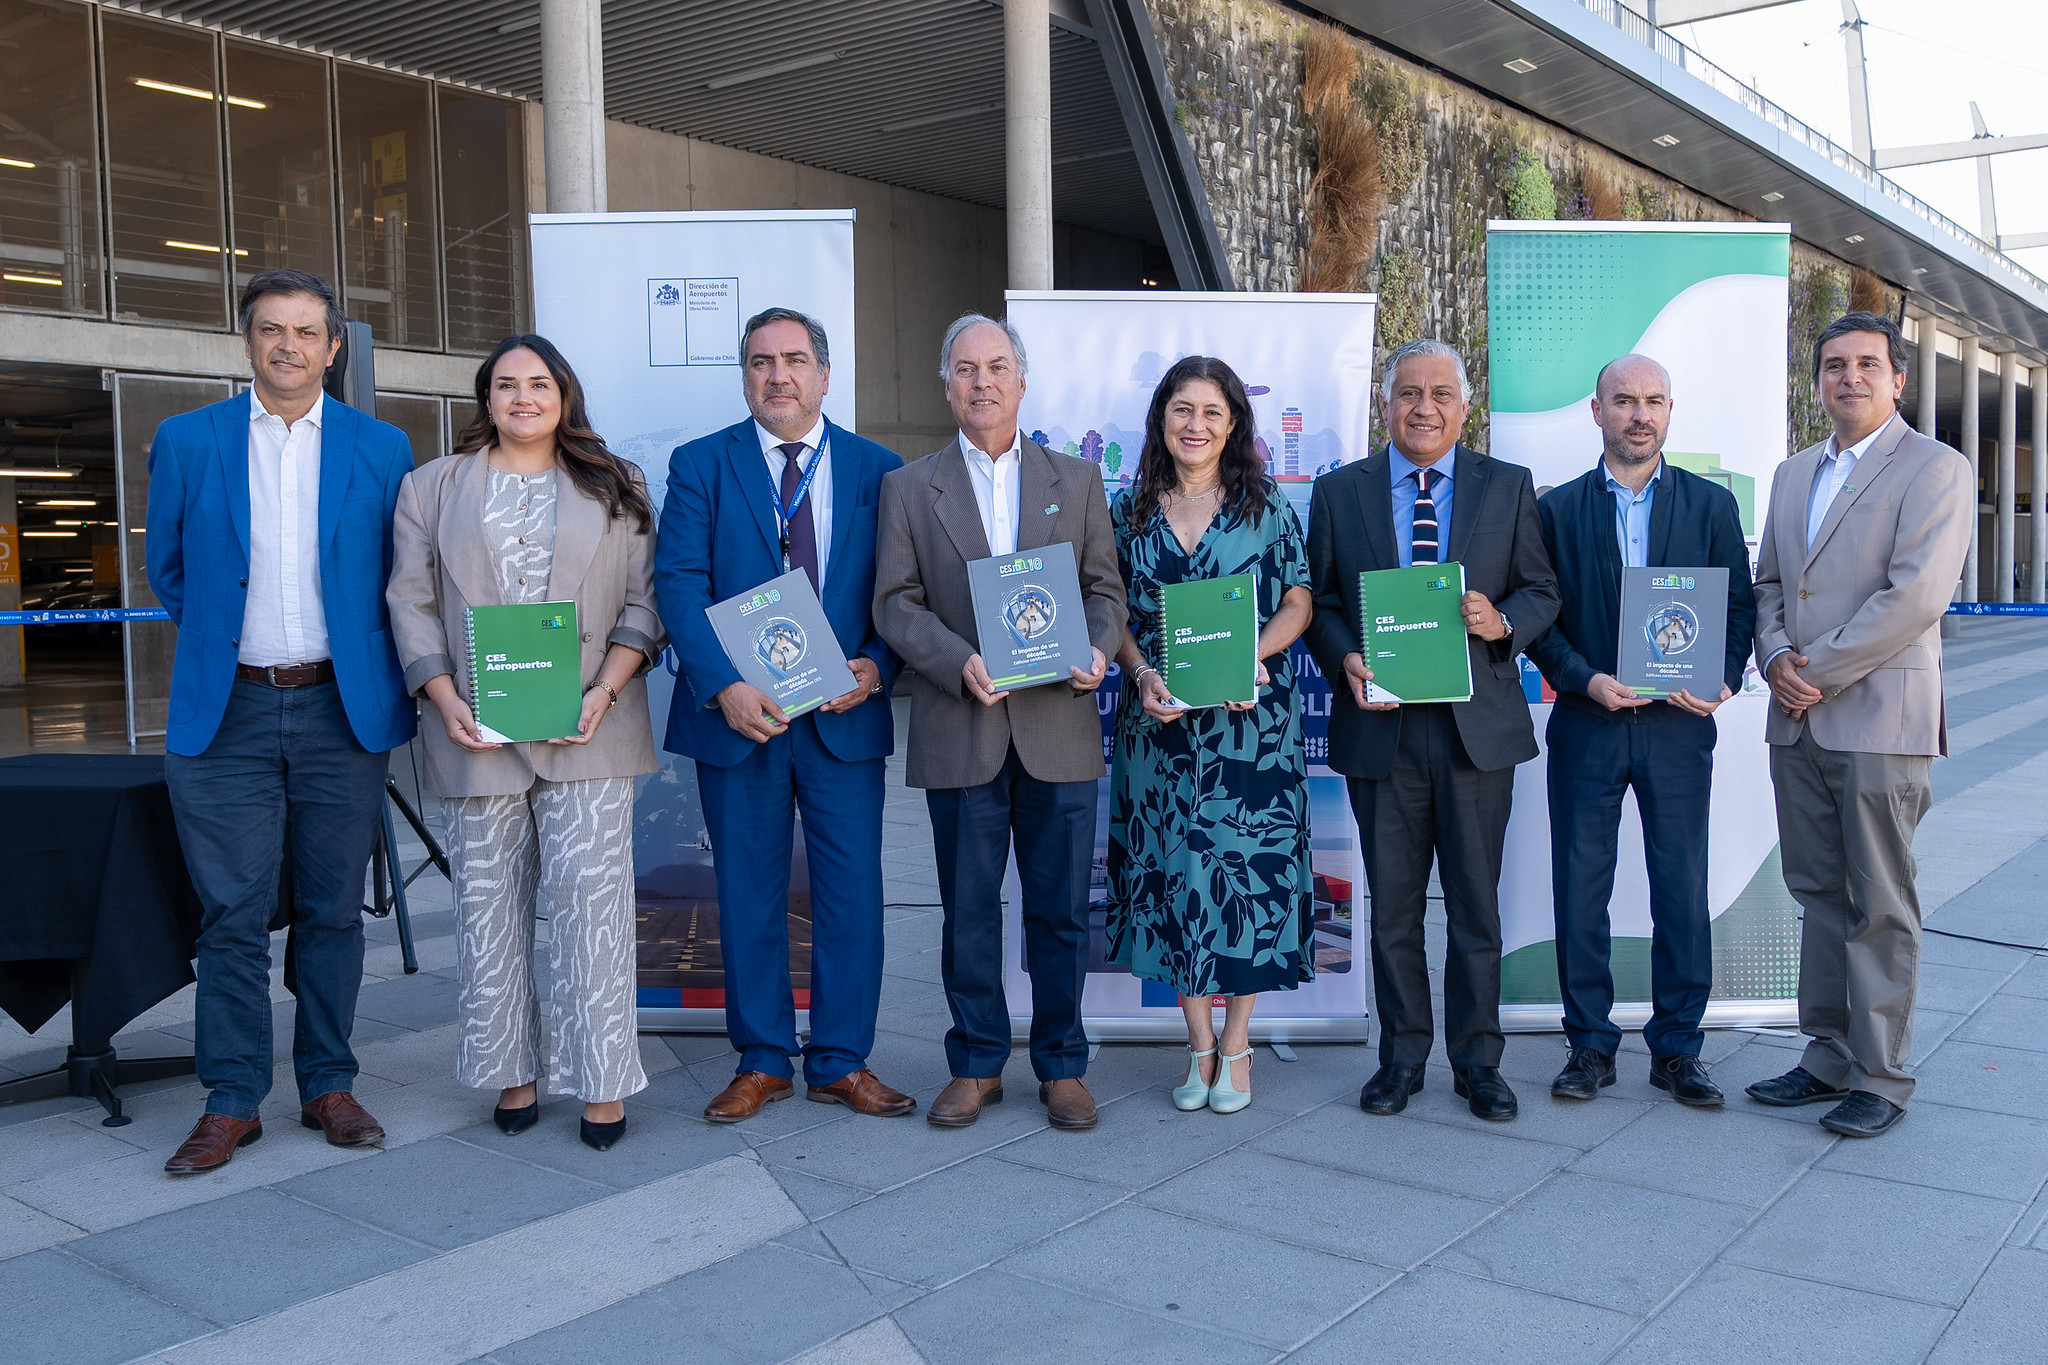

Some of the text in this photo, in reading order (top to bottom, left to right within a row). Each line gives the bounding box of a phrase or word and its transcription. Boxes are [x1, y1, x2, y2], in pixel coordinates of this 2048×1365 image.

[794, 485, 807, 507] Ministerio
[806, 466, 815, 480] Obras
[1000, 564, 1012, 574] CES
[1027, 557, 1044, 572] 10
[1652, 576, 1695, 590] CES 10
[739, 602, 752, 613] CES
[765, 589, 782, 604] 10
[1375, 616, 1395, 625] CES
[1175, 627, 1192, 636] CES
[1376, 621, 1438, 633] Aeropuertos
[1175, 630, 1232, 645] Aeropuertos
[486, 654, 507, 662] CES
[1026, 650, 1046, 658] década
[486, 660, 552, 672] Aeropuertos
[789, 678, 807, 689] década
